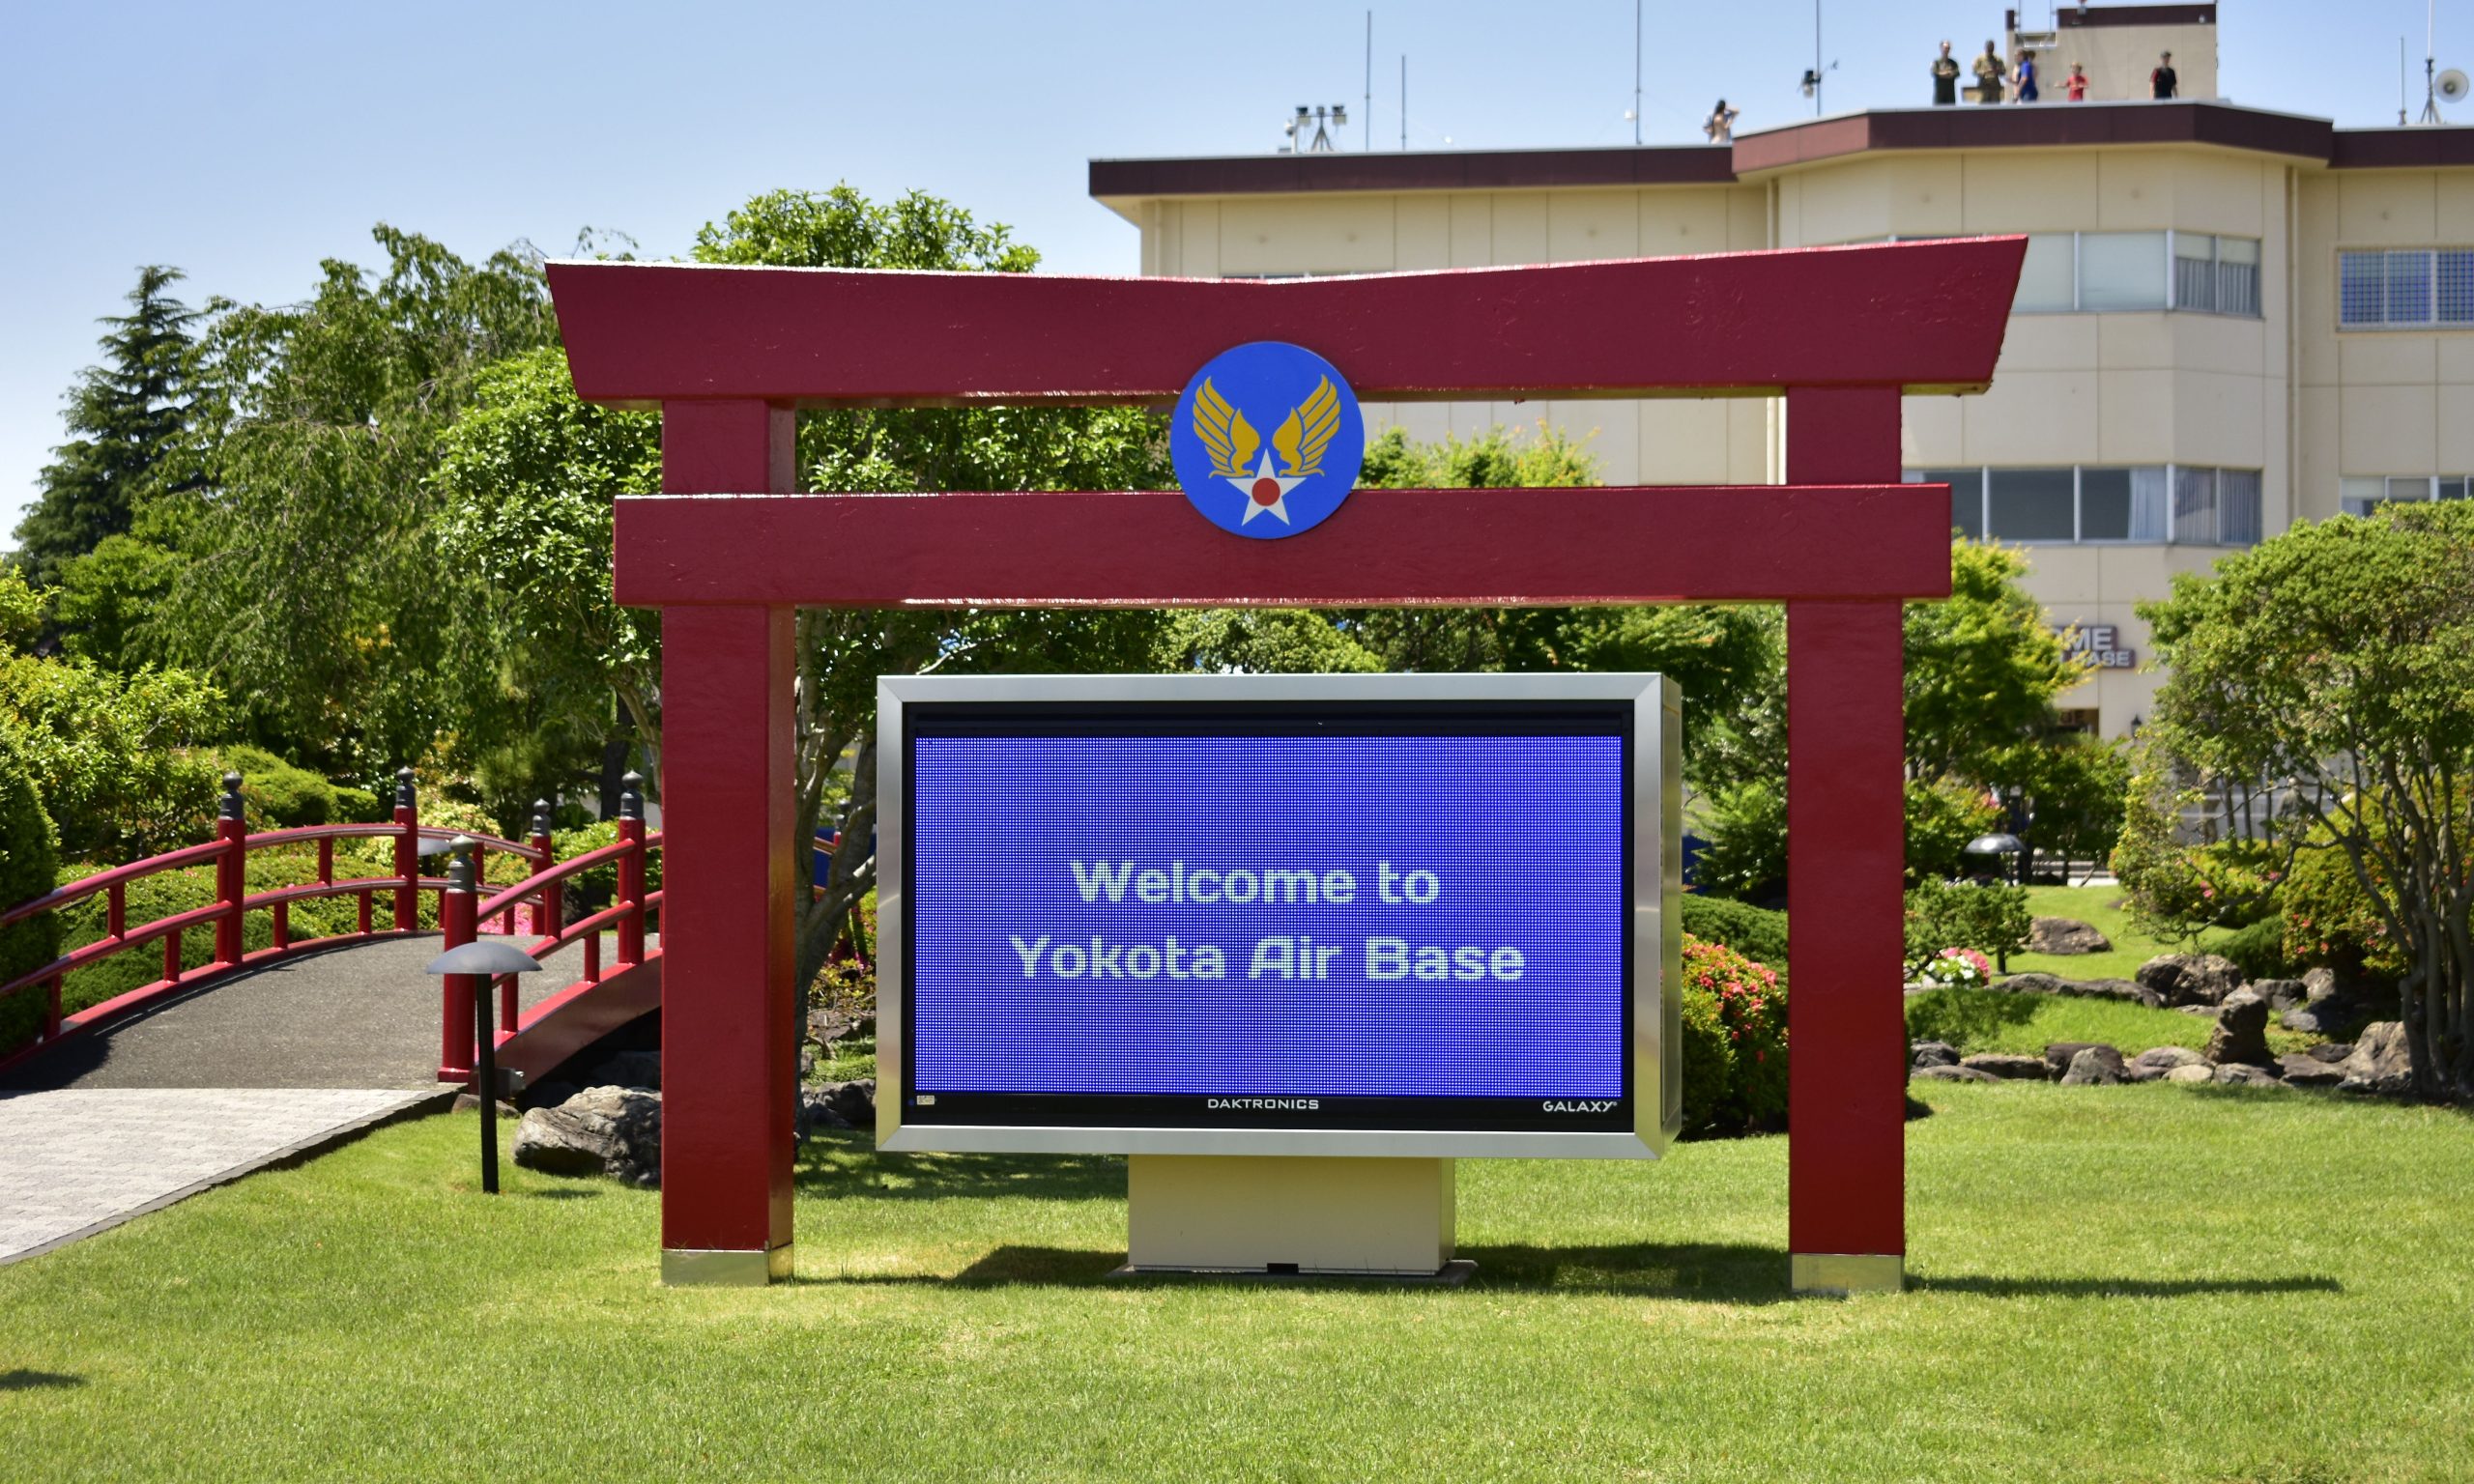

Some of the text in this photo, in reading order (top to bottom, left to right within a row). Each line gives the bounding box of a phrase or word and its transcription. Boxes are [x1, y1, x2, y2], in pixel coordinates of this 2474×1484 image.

[1070, 859, 1441, 904] Welcome to
[1011, 934, 1526, 982] Yokota Air Base
[1207, 1098, 1319, 1110] DAKTRONICS
